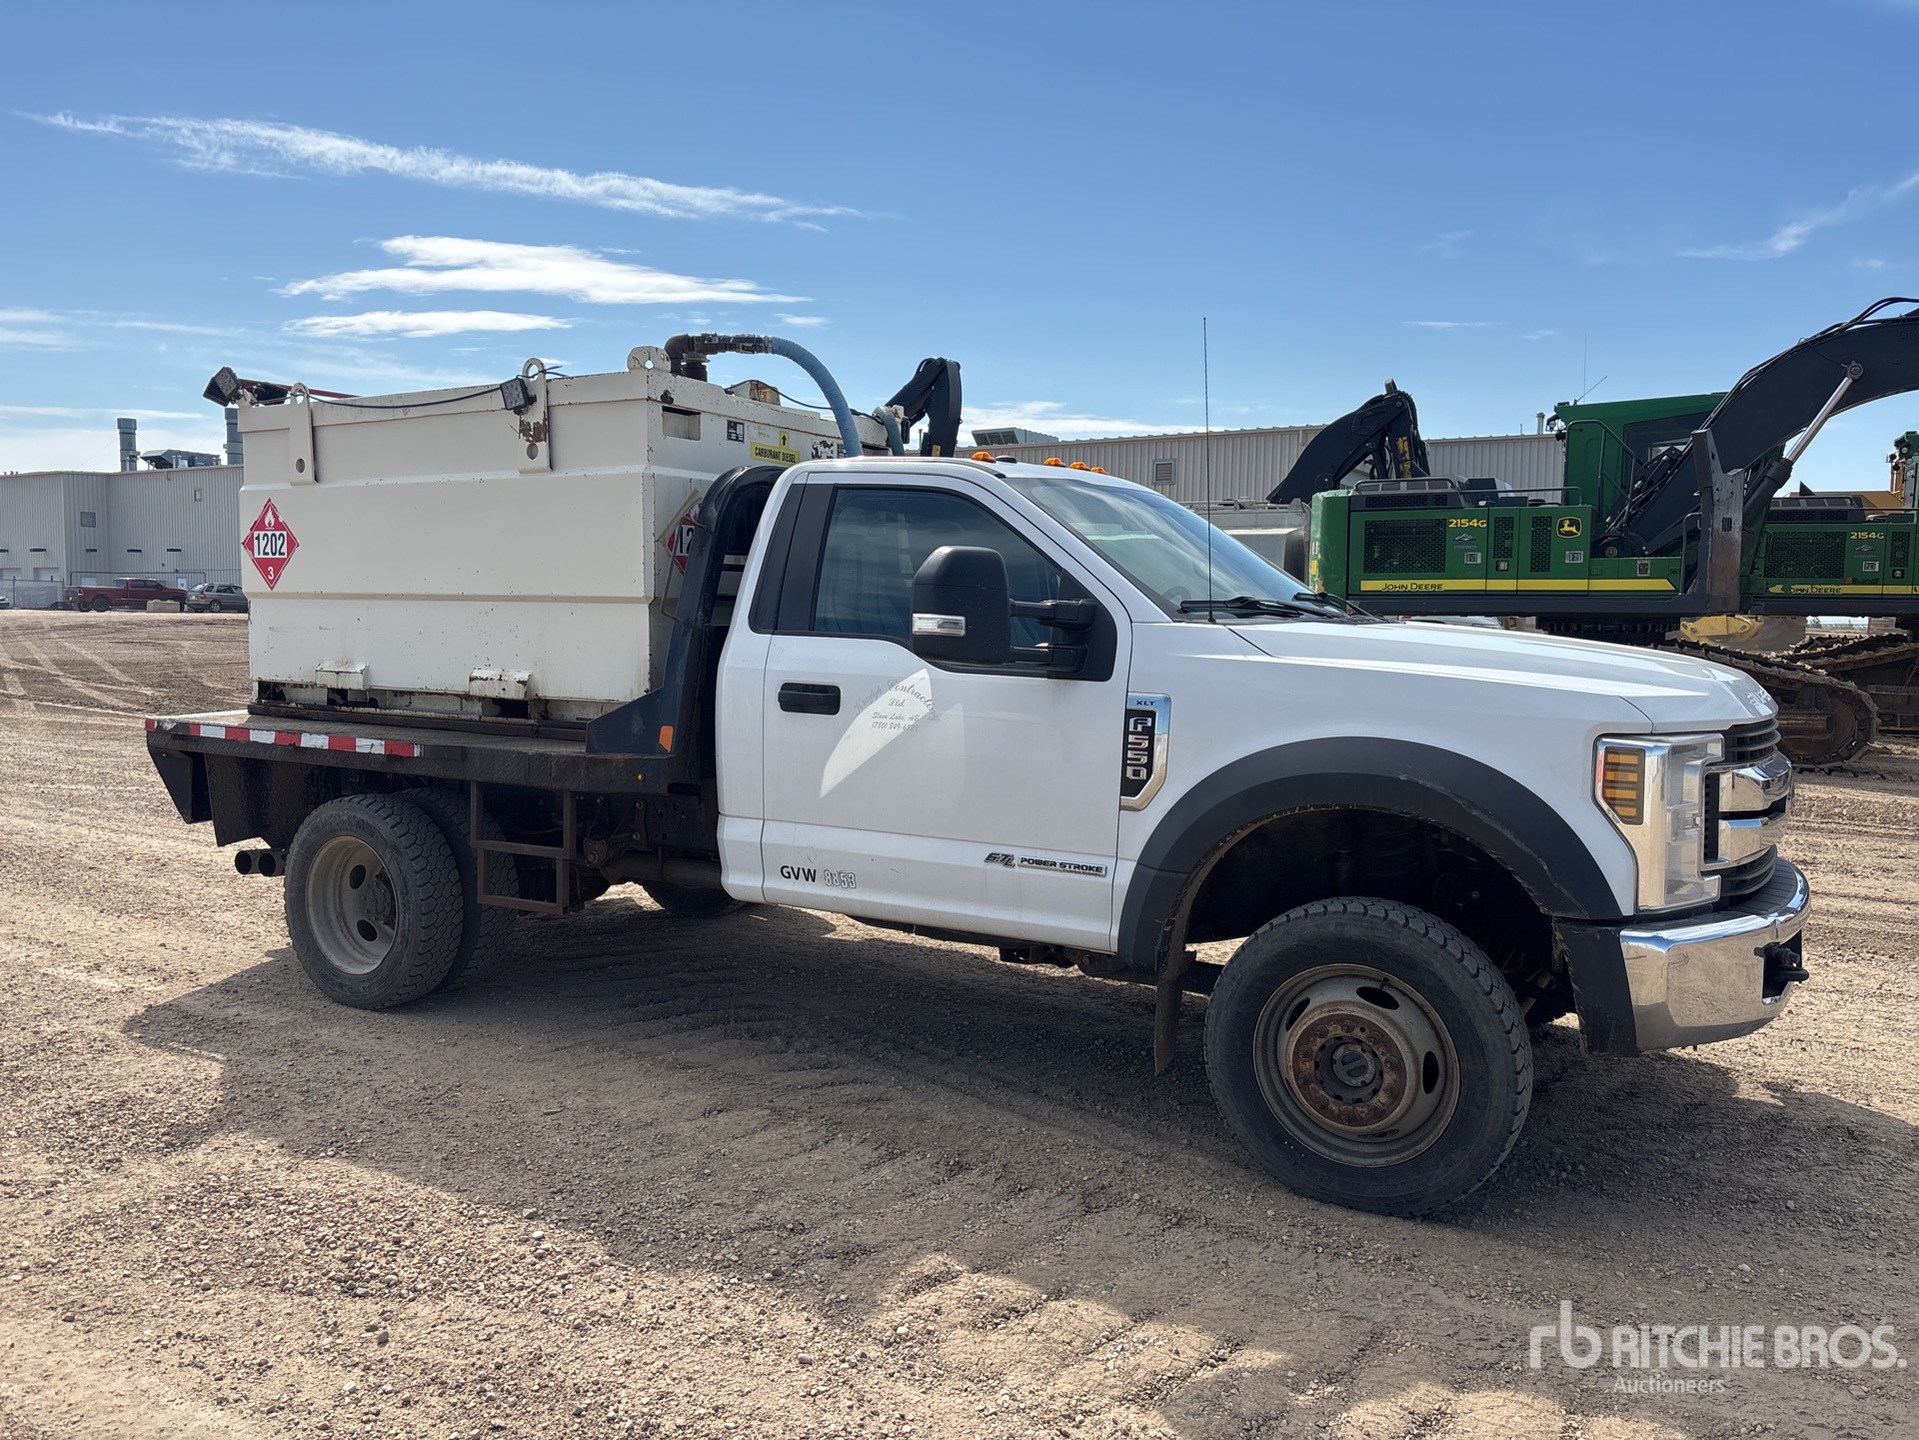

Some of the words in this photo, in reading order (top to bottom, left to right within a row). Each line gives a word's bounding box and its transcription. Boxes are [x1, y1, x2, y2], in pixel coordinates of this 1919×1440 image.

[754, 446, 781, 460] CARBURANT
[782, 451, 796, 464] DIESEL
[1448, 518, 1487, 528] 2154G
[679, 525, 695, 554] 12
[1850, 531, 1885, 540] 2154G
[255, 533, 285, 556] 1202
[268, 566, 274, 580] 3
[1381, 582, 1409, 591] JOHN
[1410, 582, 1444, 591] DEERE
[1810, 585, 1842, 594] DEERE
[888, 698, 905, 708] Ltd.
[1126, 717, 1152, 780] F550
[1020, 857, 1057, 867] POWER
[1059, 862, 1103, 873] STROKE
[780, 865, 817, 883] GVW
